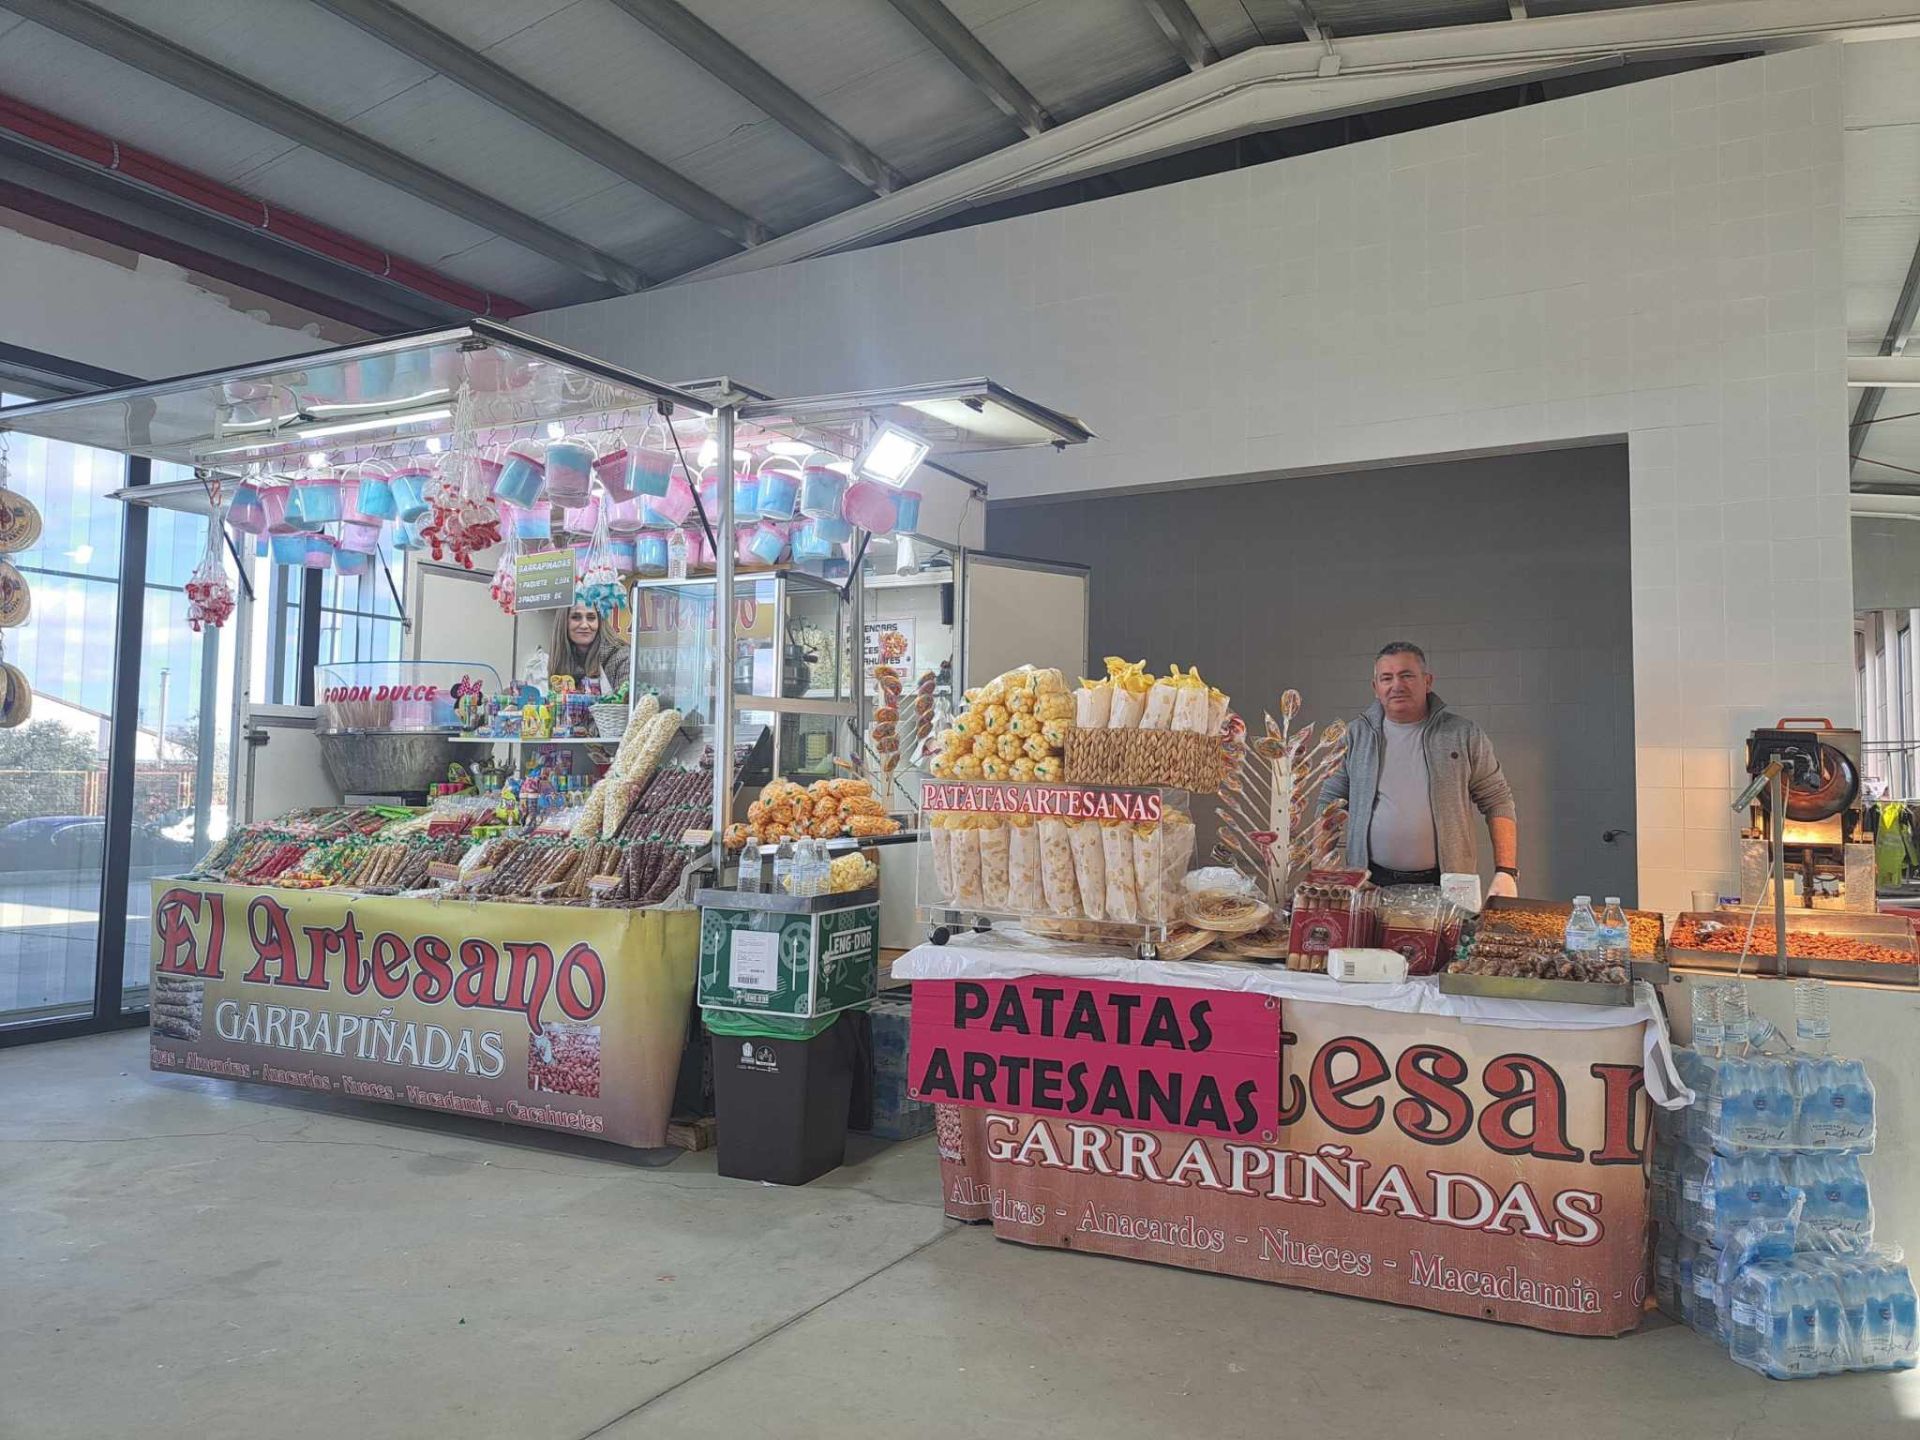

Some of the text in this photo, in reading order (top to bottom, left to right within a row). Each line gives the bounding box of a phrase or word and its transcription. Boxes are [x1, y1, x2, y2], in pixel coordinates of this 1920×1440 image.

[376, 685, 437, 702] DULCE
[155, 887, 607, 1036] El Artesano
[215, 999, 507, 1079] GARRAPIÑADAS
[954, 982, 1213, 1052] PATATAS
[342, 1074, 395, 1100] Nueces
[406, 1085, 494, 1115] Macadamia
[506, 1099, 604, 1132] Cacahuetes
[920, 1048, 1259, 1135] ARTESANAS
[986, 1114, 1604, 1247] GARRAPIÑADAS
[1076, 1198, 1225, 1254] Anacardos
[1258, 1226, 1373, 1277] Nueces
[1408, 1250, 1602, 1314] Macadamia
